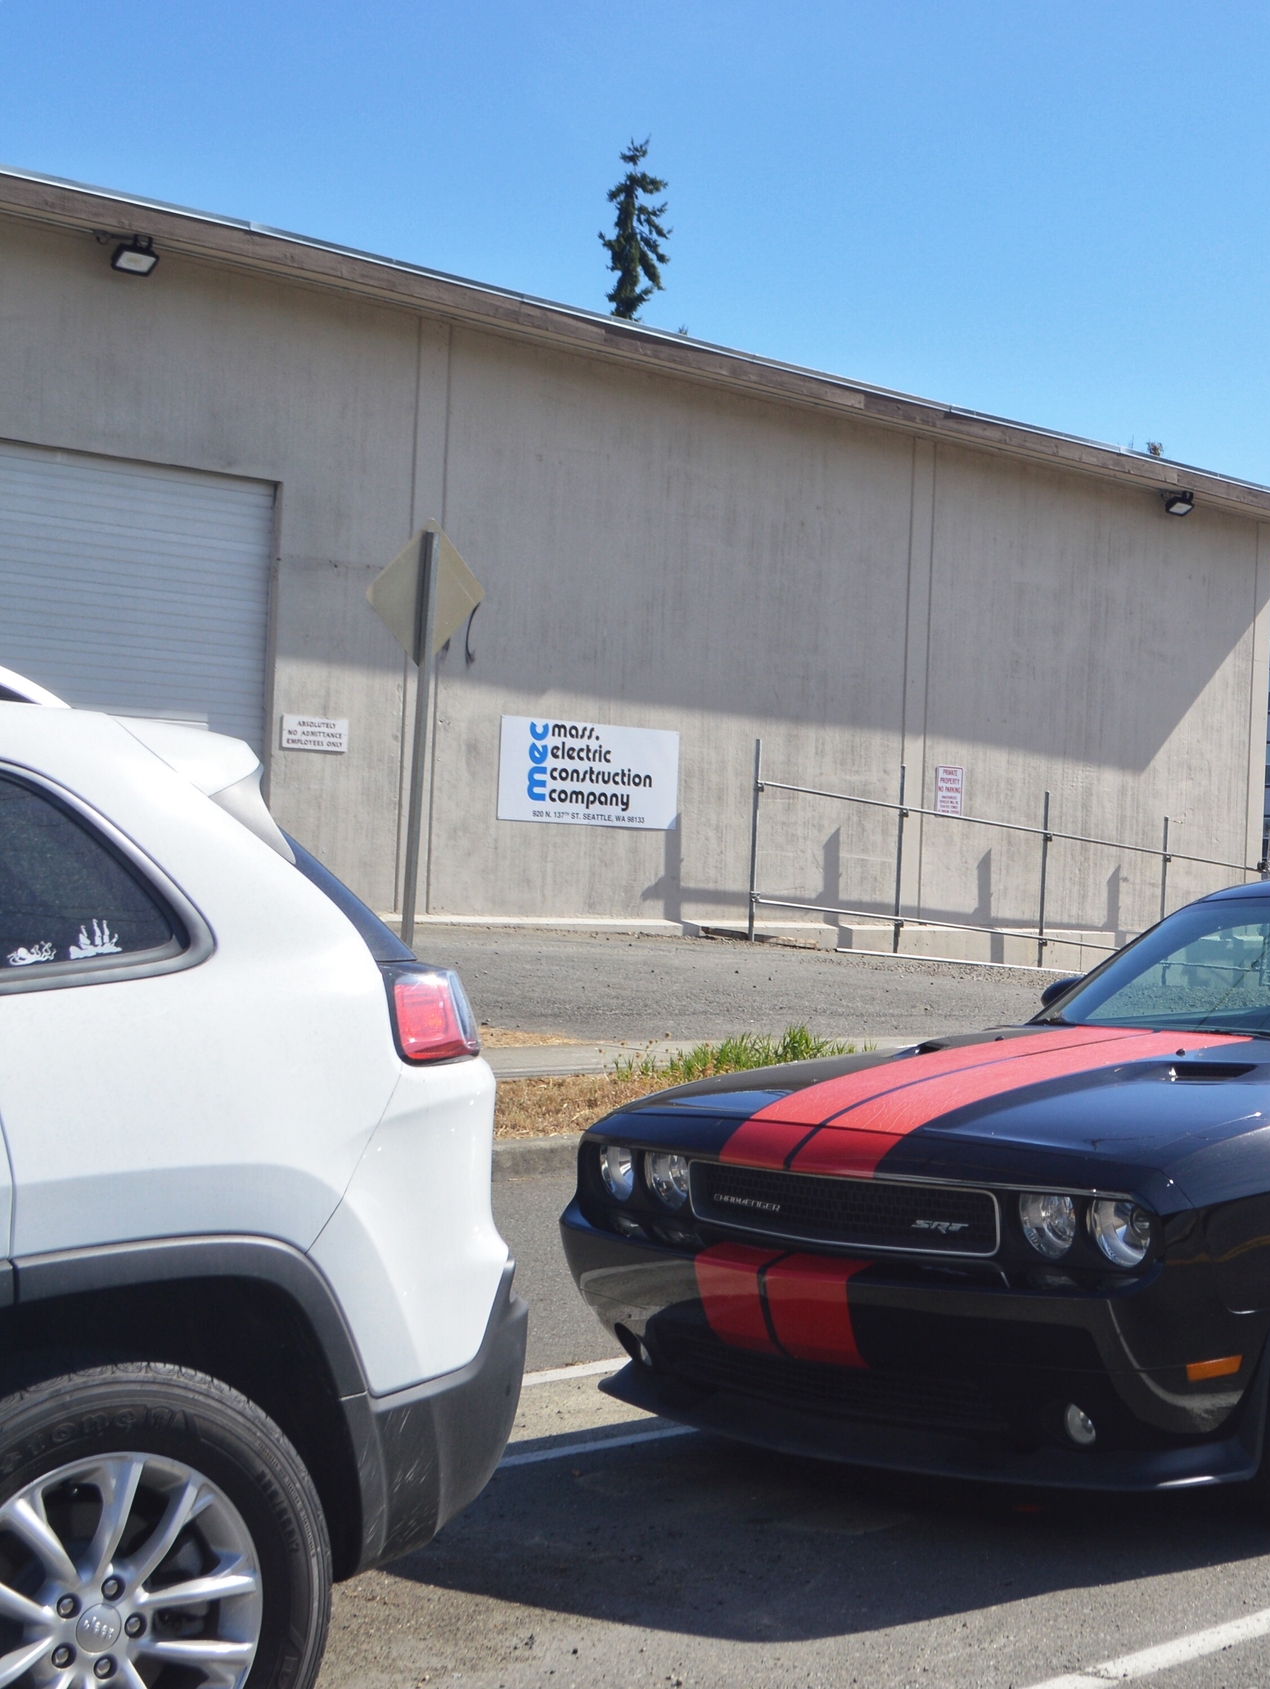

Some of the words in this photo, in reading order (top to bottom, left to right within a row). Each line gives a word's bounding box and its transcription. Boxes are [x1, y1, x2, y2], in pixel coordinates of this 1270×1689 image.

[297, 720, 336, 729] ABSOLUTELY
[301, 730, 342, 740] ADMITTANCE
[551, 723, 600, 741] mass.
[286, 738, 324, 747] EMPLOYEES
[550, 741, 612, 763] electric
[549, 766, 653, 788] construction
[548, 788, 630, 812] company
[583, 813, 613, 822] SEATTLE,
[627, 816, 645, 824] 98133
[911, 1220, 969, 1234] SRT
